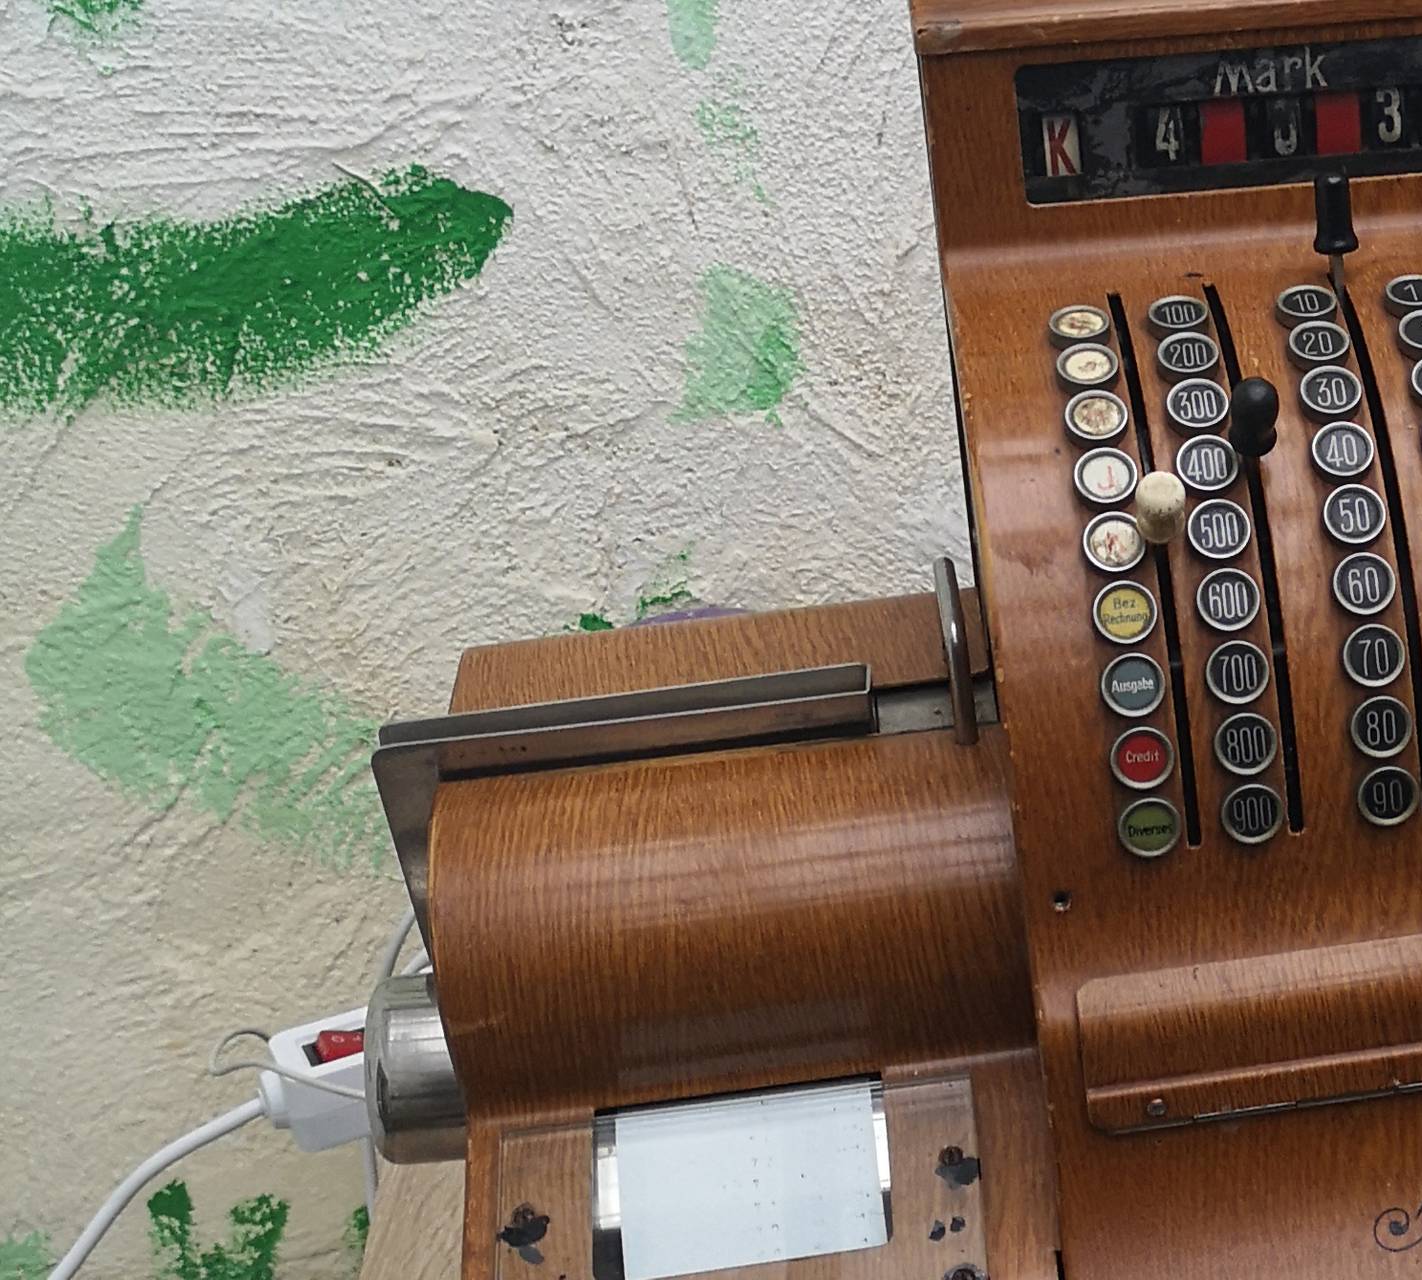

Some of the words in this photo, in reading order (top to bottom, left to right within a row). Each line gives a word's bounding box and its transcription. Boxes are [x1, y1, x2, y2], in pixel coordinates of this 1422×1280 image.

[1213, 46, 1328, 97] Mark
[1046, 119, 1074, 176] K
[1156, 106, 1181, 161] 4
[1377, 88, 1401, 142] 3
[1293, 293, 1319, 313] 10
[1404, 284, 1419, 302] 1
[1161, 304, 1196, 324] 100
[1169, 343, 1207, 367] 200
[1302, 331, 1333, 355] 20
[1179, 391, 1218, 420] 300
[1316, 377, 1347, 407] 30
[1187, 447, 1228, 482] 400
[1326, 434, 1358, 467] 40
[1200, 512, 1239, 549] 500
[1339, 497, 1371, 534] 50
[1208, 581, 1249, 619] 600
[1348, 566, 1380, 604] 60
[1219, 654, 1257, 692] 700
[1358, 638, 1389, 677] 70
[1111, 677, 1155, 694] Ausgabe
[1367, 708, 1396, 746] 80
[1125, 749, 1160, 764] Credit
[1226, 726, 1266, 764] 800
[1373, 779, 1403, 814] 90
[1127, 821, 1173, 838] Diverses
[1233, 796, 1272, 833] 900
